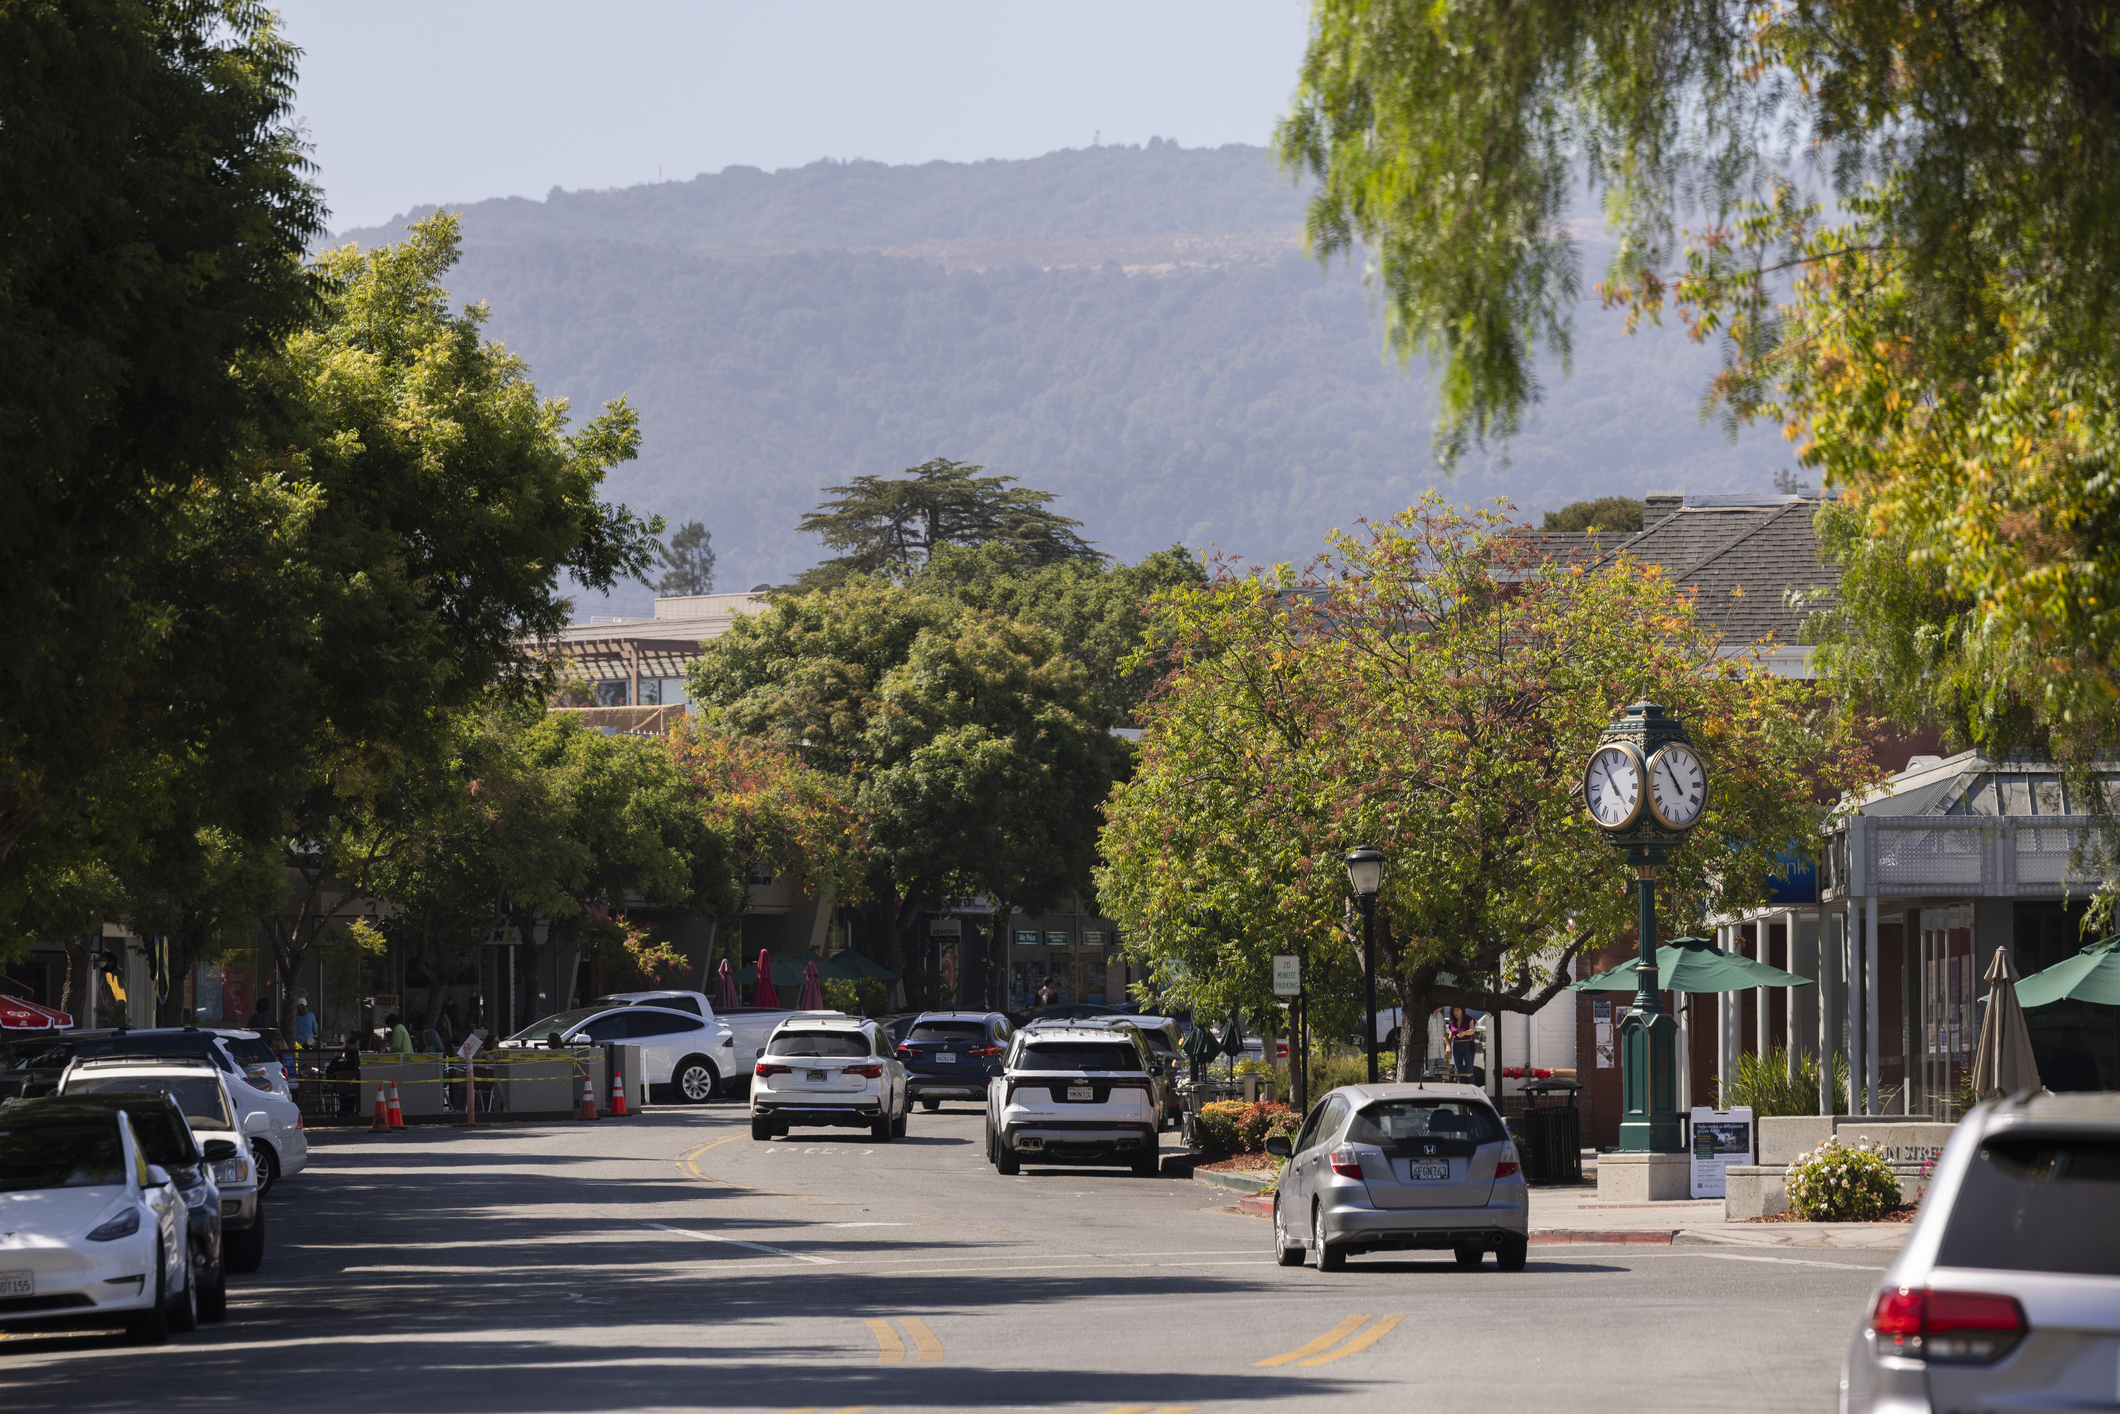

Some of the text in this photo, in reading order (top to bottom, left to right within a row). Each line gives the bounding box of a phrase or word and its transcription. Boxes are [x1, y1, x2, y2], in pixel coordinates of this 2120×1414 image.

[1283, 961, 1291, 969] 20
[1276, 982, 1298, 990] PARKING
[376, 997, 395, 1005] SALE
[0, 1280, 30, 1293] DT155
